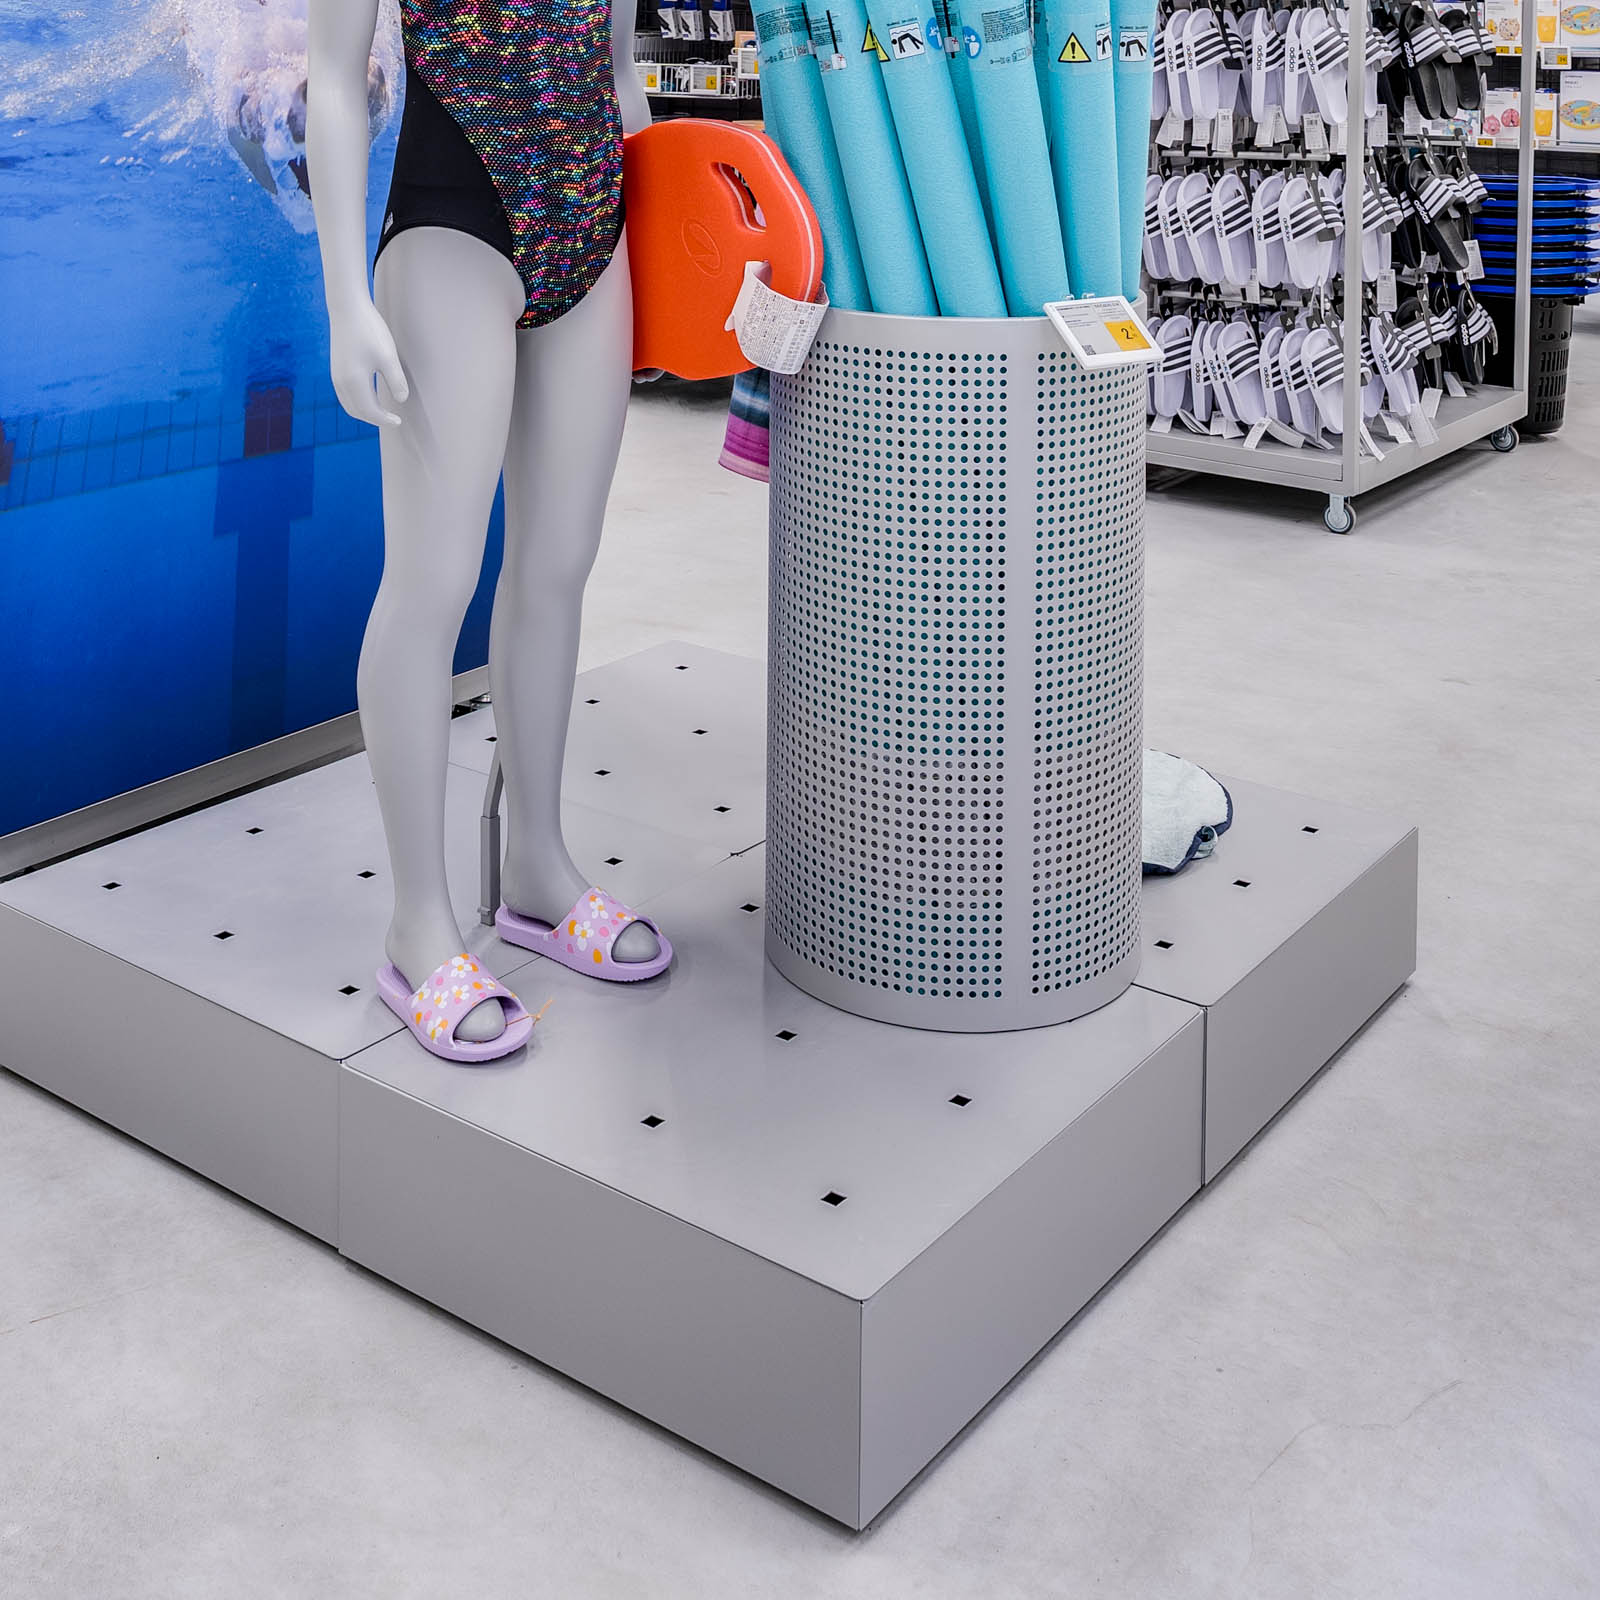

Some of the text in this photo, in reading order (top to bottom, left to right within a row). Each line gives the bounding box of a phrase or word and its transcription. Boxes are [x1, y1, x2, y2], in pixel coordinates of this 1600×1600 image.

[1404, 41, 1415, 68] adidas
[1414, 200, 1431, 224] adidas
[1460, 323, 1469, 346] adidas
[1378, 353, 1390, 376] adidas
